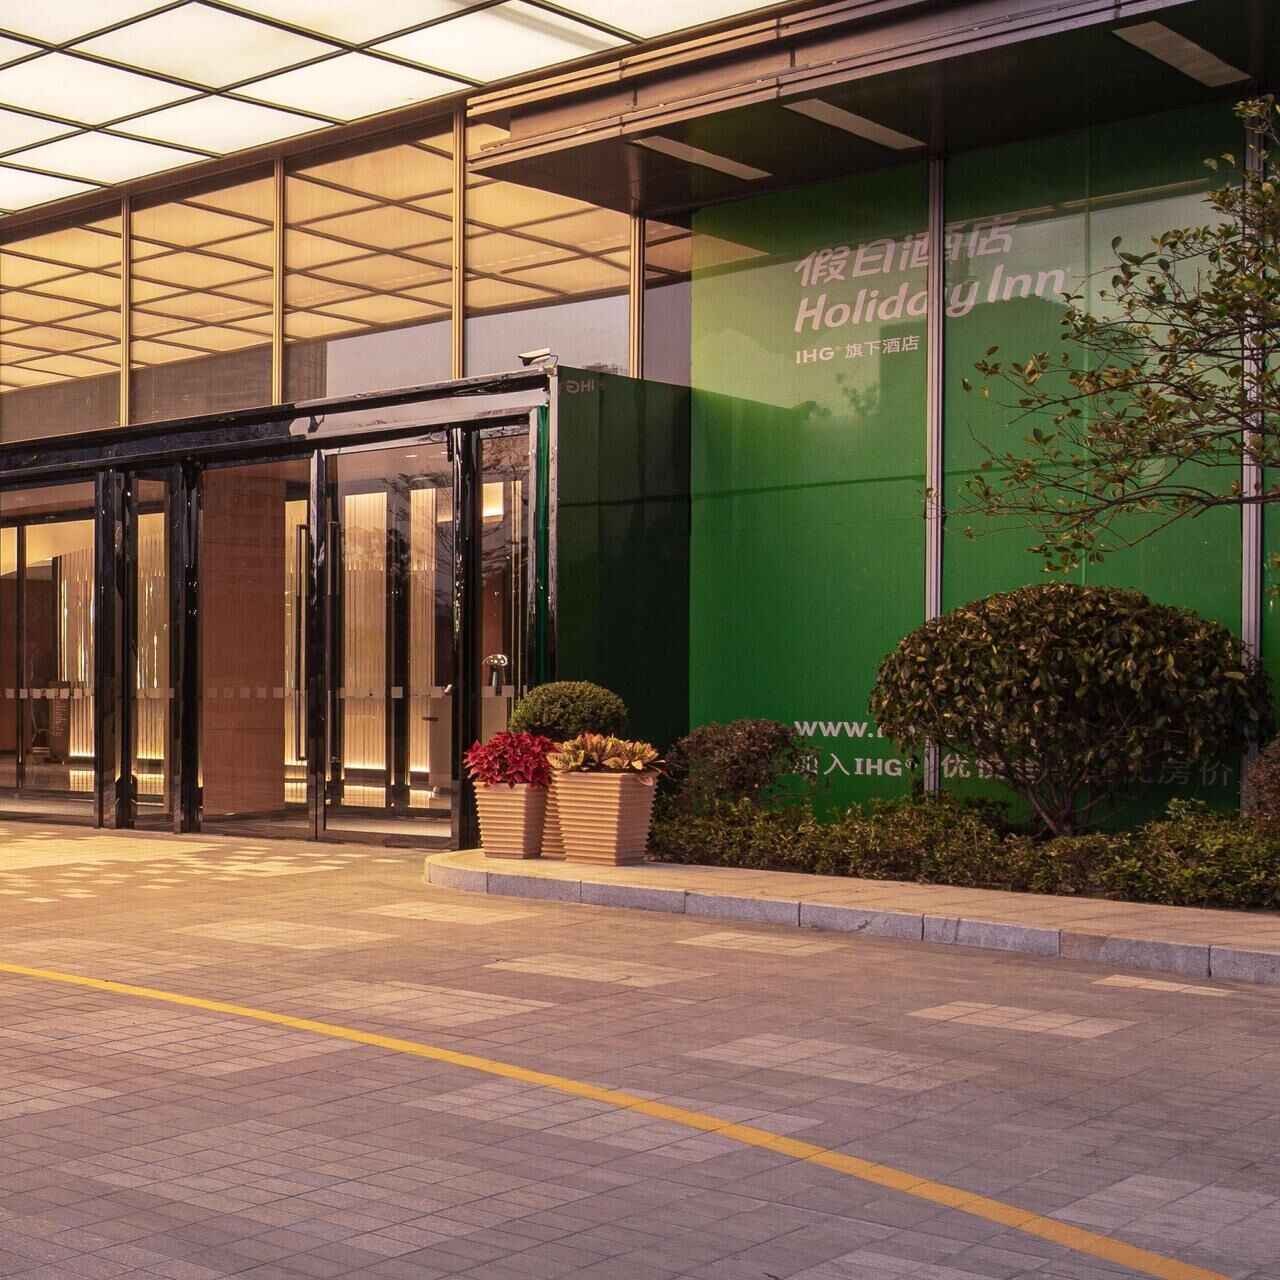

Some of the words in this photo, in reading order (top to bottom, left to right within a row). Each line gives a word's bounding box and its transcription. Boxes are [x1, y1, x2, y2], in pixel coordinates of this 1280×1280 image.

[795, 216, 1020, 287] 假日酒店
[794, 281, 980, 333] Holiday
[986, 263, 1065, 304] Inn
[844, 335, 921, 359] 旗下酒店
